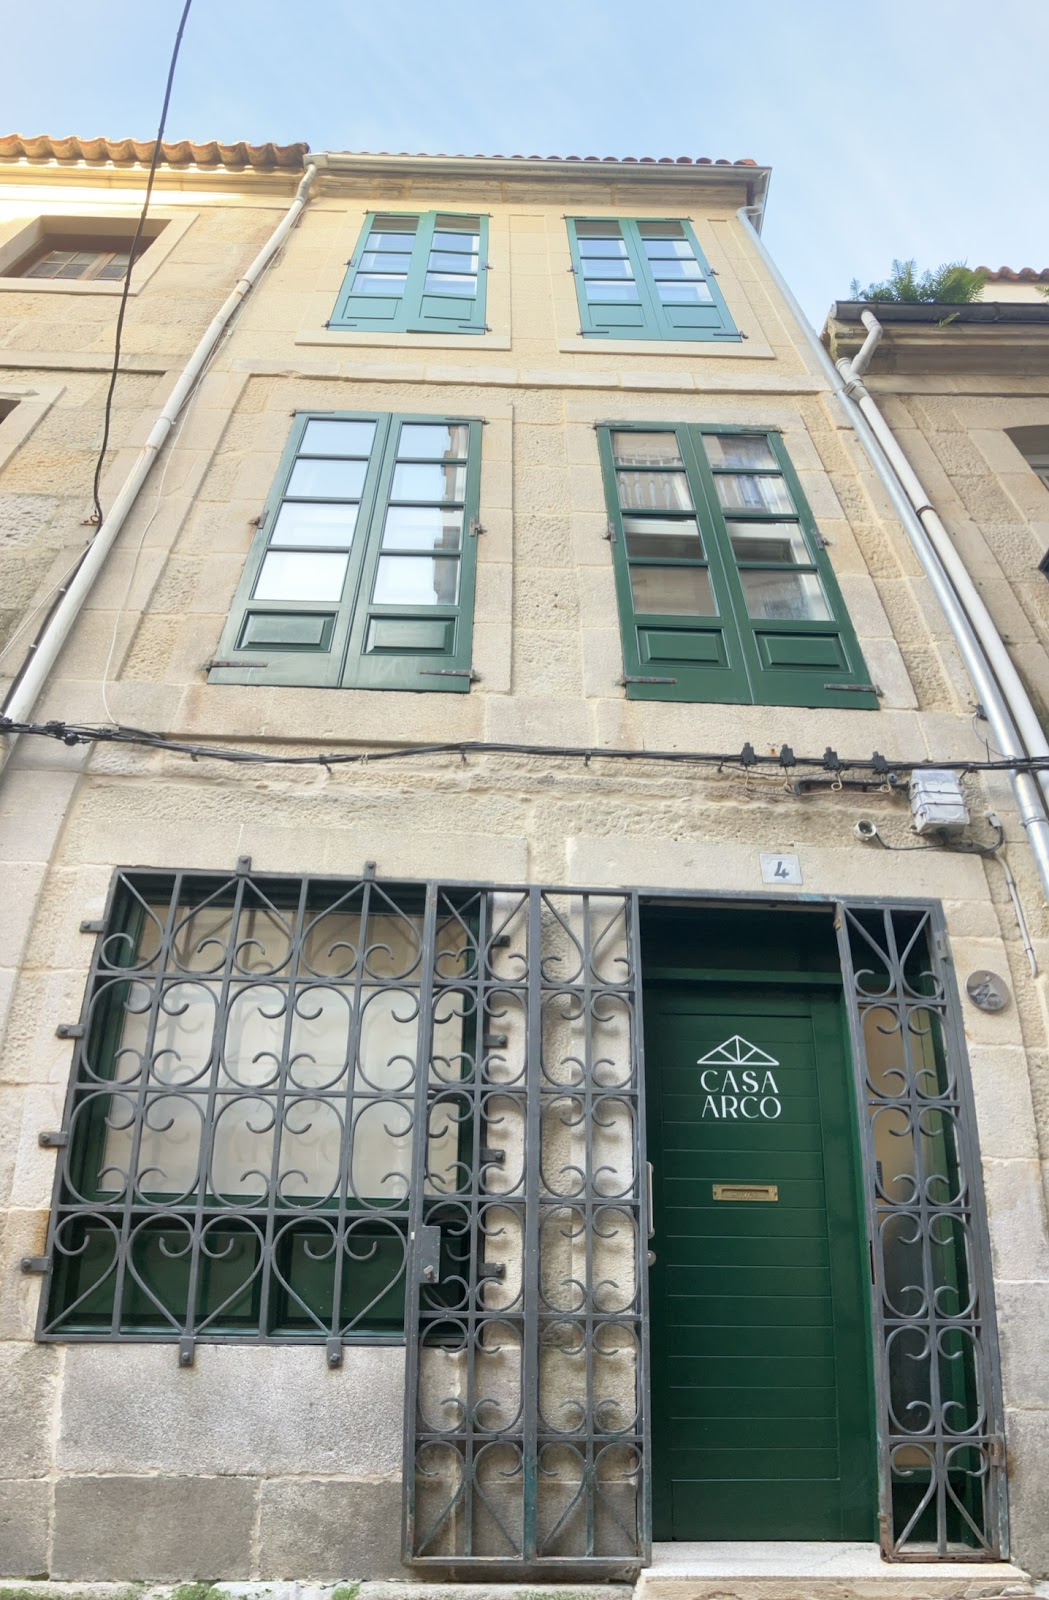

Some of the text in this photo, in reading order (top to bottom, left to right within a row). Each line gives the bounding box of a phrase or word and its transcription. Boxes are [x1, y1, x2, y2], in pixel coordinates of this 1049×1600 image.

[774, 861, 789, 879] 4
[700, 1069, 779, 1094] CASA
[701, 1095, 782, 1119] ARCO
